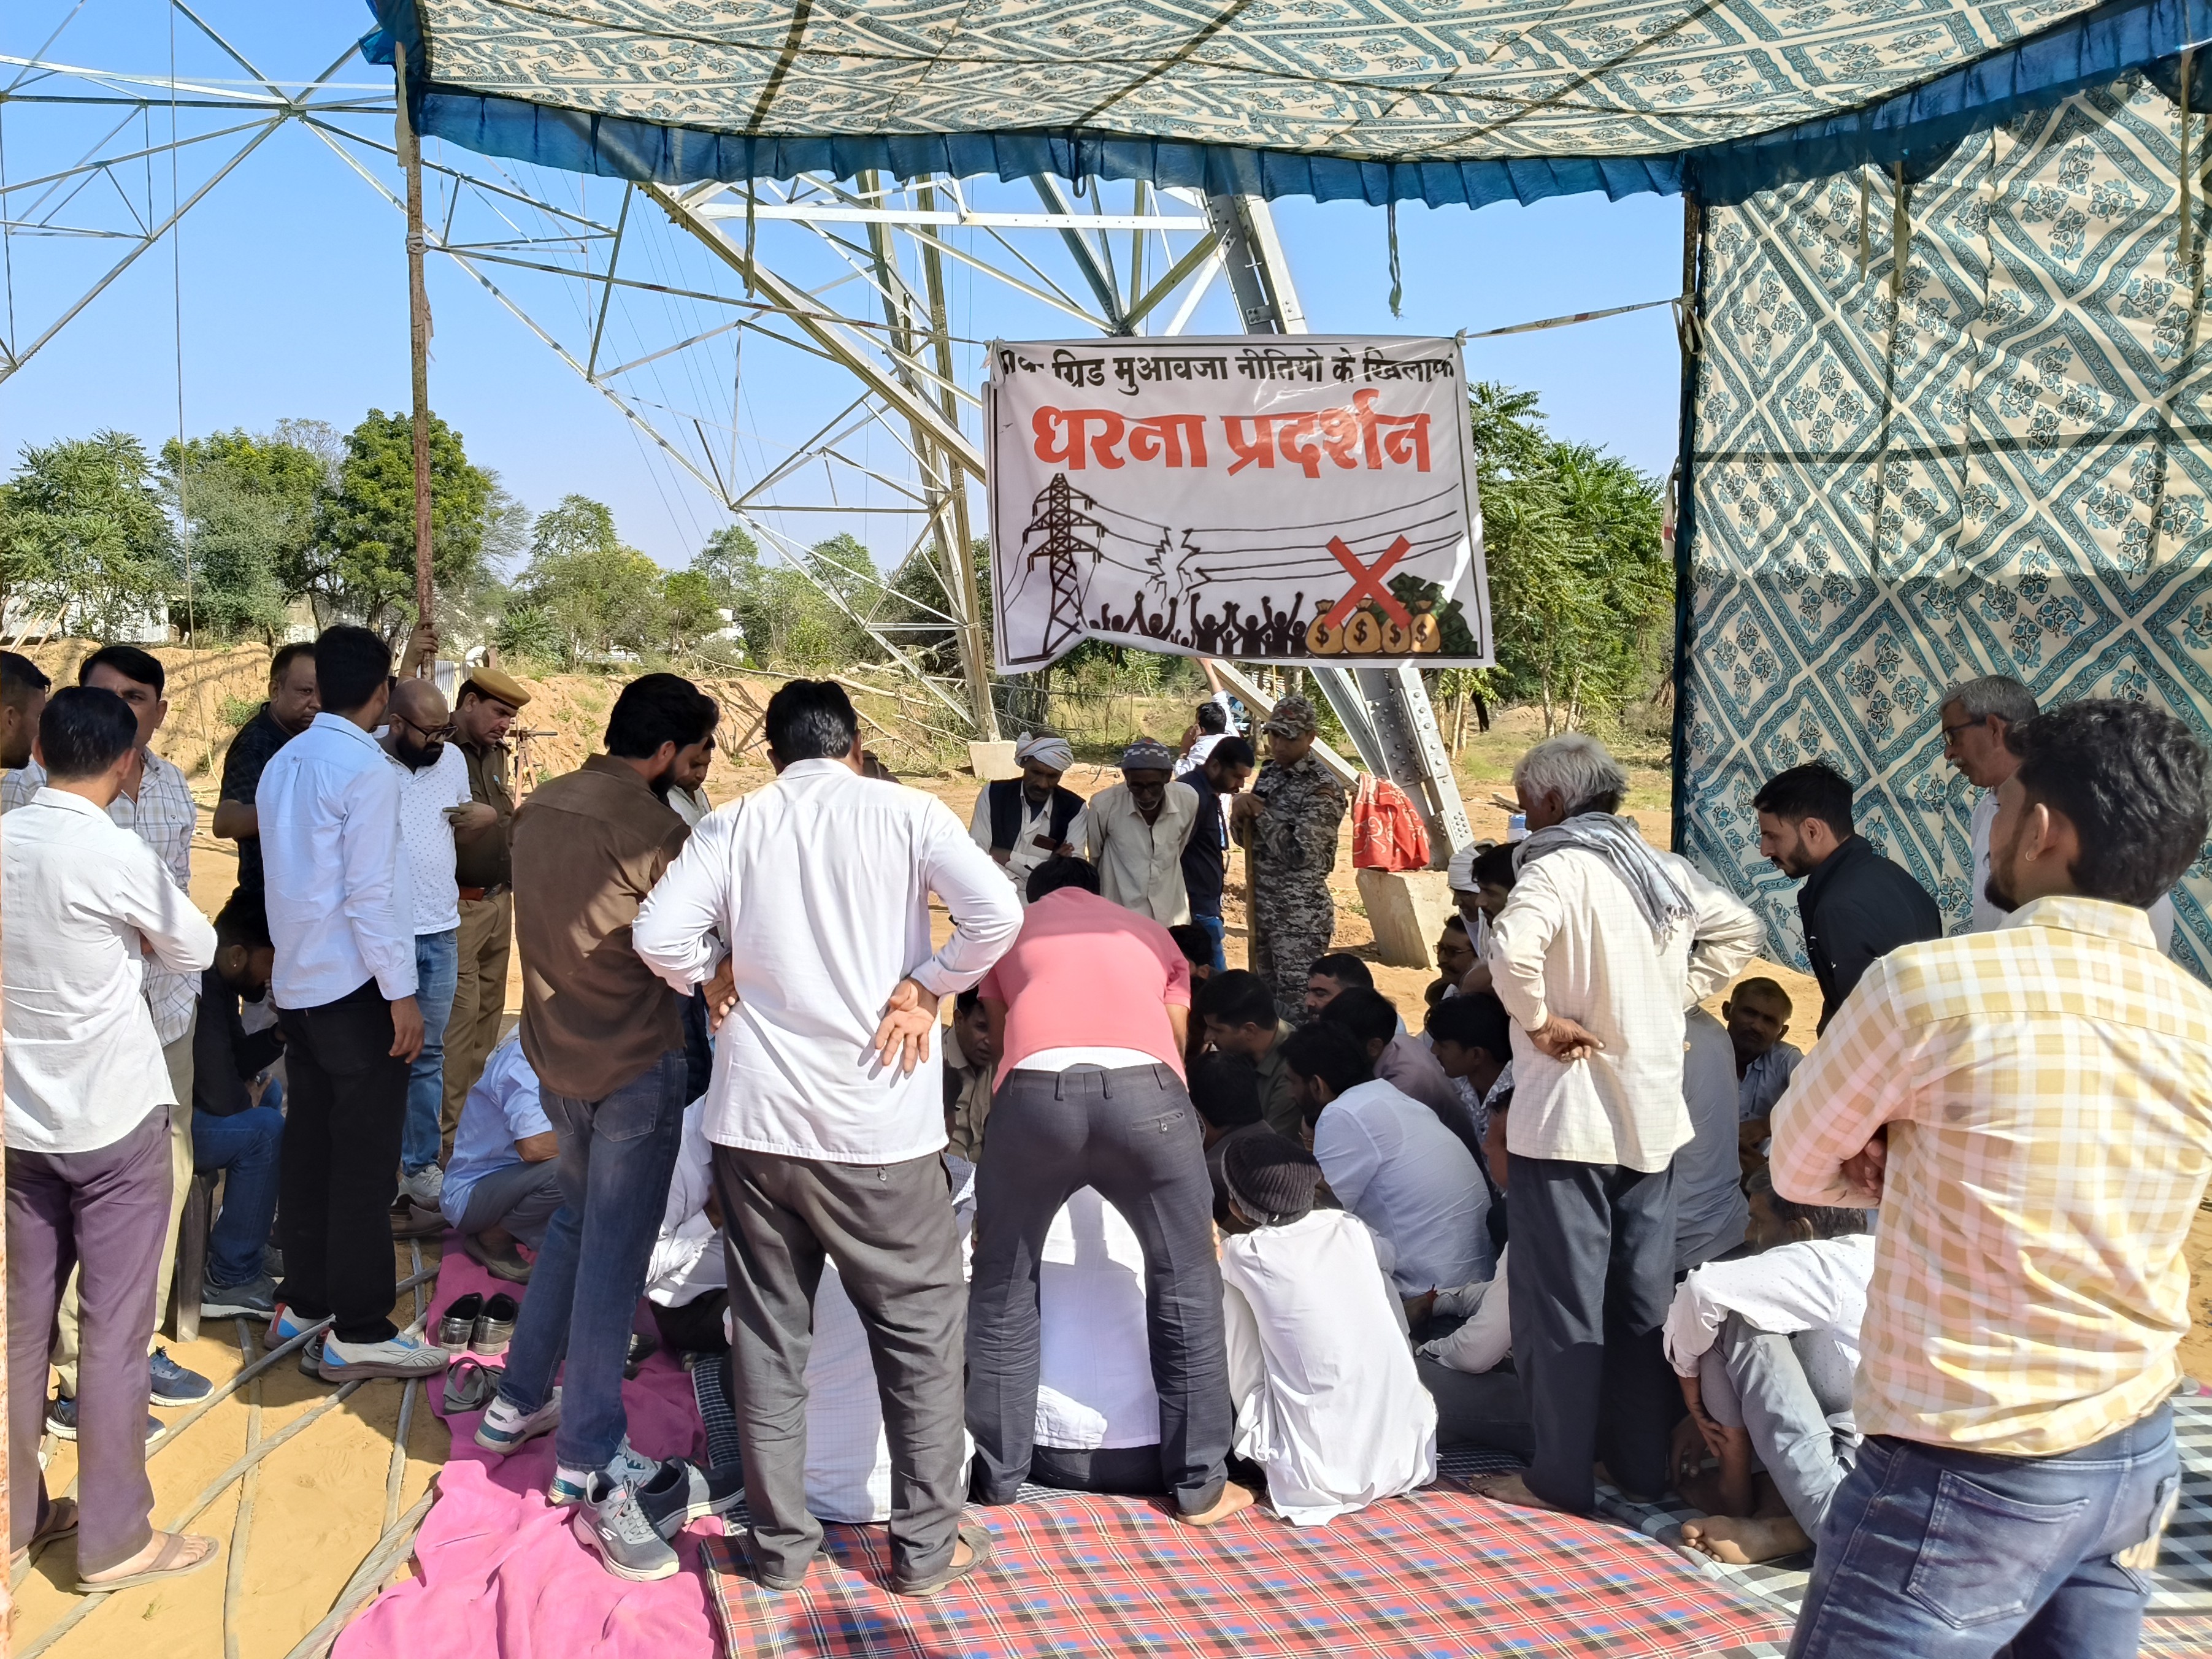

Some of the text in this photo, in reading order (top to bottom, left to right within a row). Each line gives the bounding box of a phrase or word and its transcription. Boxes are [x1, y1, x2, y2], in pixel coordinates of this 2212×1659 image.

[1051, 348, 1105, 388] ग्रिड
[1112, 356, 1228, 396] मुआवजा
[1331, 347, 1356, 384] के
[1032, 388, 1431, 478] धरना प्रदर्शन
